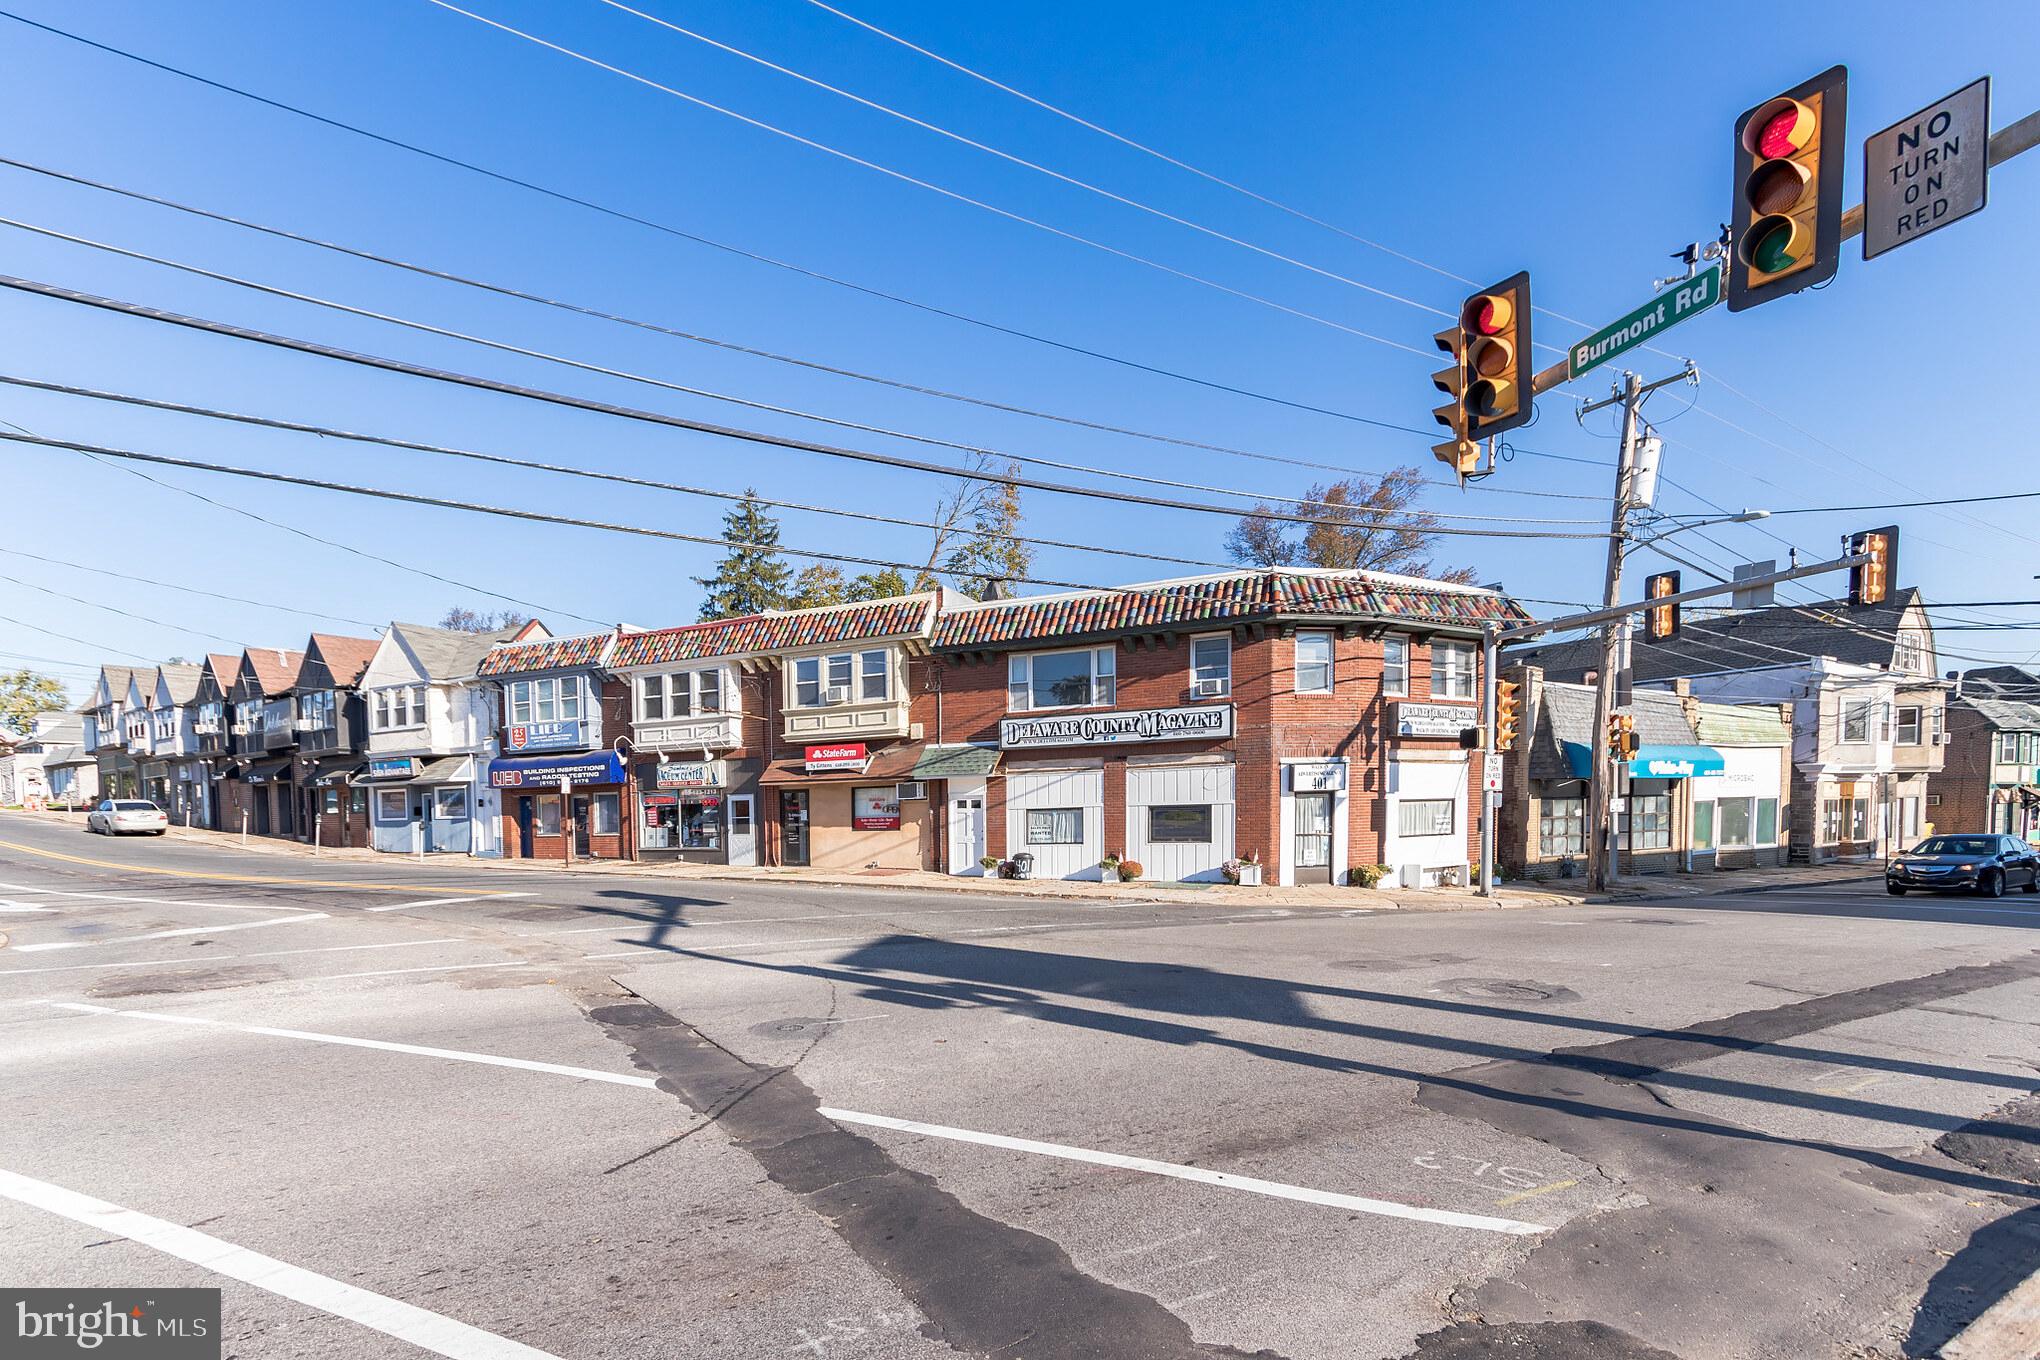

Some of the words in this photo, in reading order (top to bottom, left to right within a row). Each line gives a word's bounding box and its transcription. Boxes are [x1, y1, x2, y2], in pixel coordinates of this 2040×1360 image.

[1897, 110, 1952, 157] NO
[1889, 136, 1960, 185] TURN
[1904, 172, 1942, 205] ON
[1897, 198, 1949, 236] RED
[1576, 302, 1666, 369] Burmont
[1675, 276, 1708, 315] Rd
[1006, 720, 1080, 745] DELAWARE
[1080, 717, 1138, 740] COUNTY
[1138, 711, 1223, 738] MAGAZINE
[556, 764, 606, 773] INSPECTIONS
[680, 766, 704, 780] CENTER
[1489, 757, 1498, 765] NO
[492, 770, 523, 787] LIEB
[1311, 776, 1328, 790] 401
